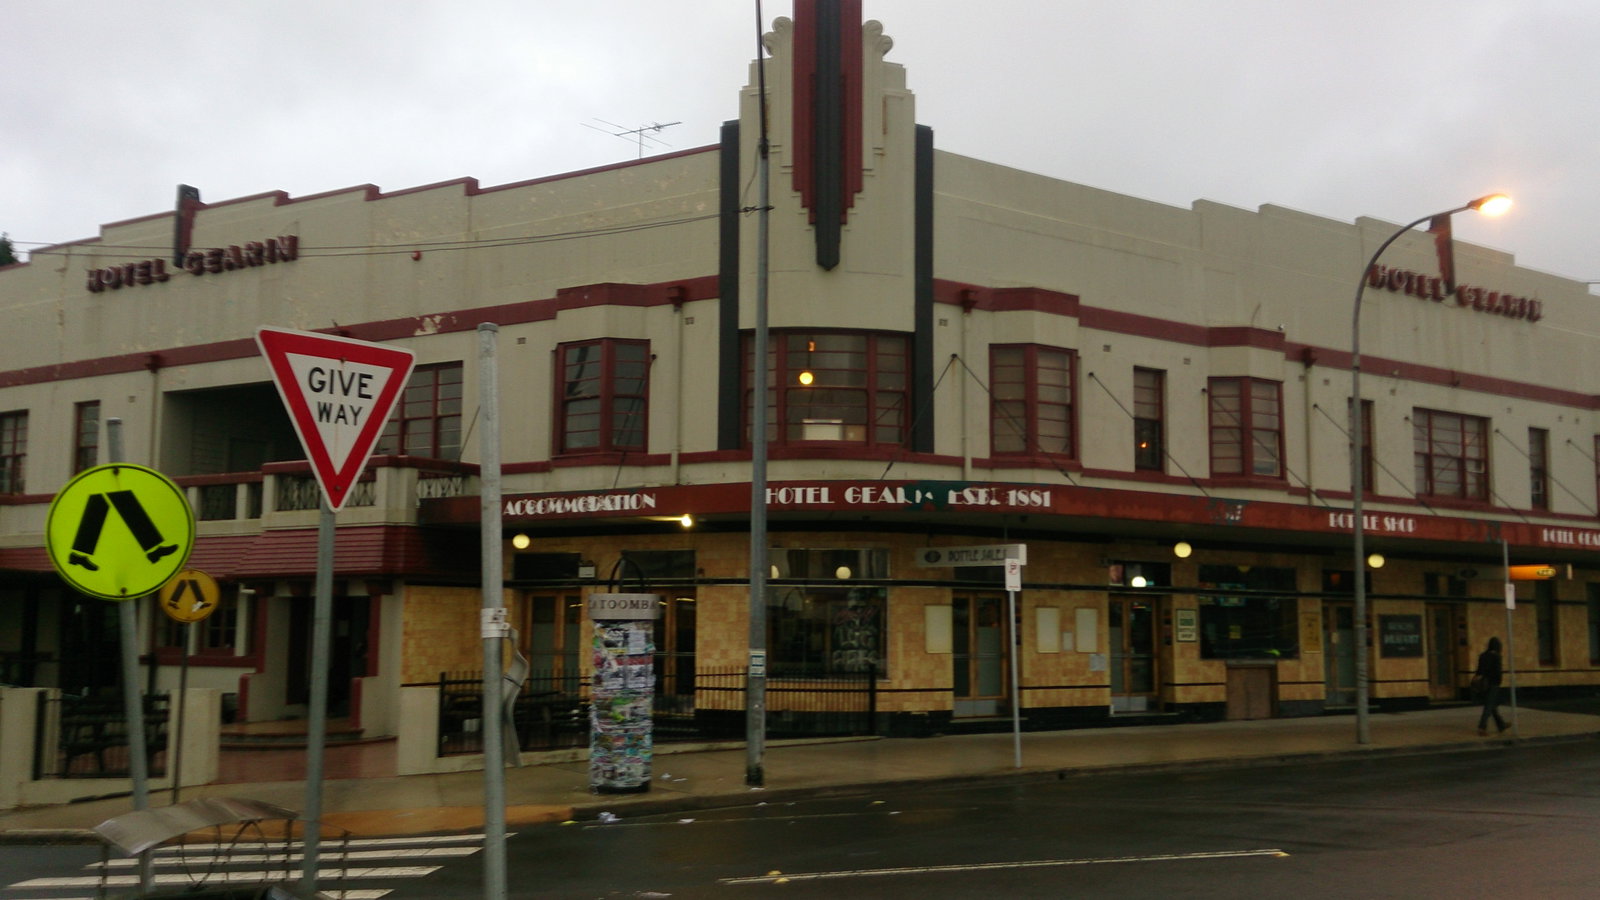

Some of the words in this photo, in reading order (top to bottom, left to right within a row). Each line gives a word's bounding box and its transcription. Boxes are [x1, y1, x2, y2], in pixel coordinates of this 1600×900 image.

[86, 257, 169, 293] HOTEL
[182, 235, 299, 276] GEARIN
[308, 366, 374, 400] GIVE
[317, 401, 364, 426] WAY
[766, 486, 834, 505] HOTEL
[1009, 488, 1051, 508] 1881
[1328, 512, 1380, 531] BOTLE
[1384, 515, 1416, 533] SHOP
[1542, 527, 1575, 545] HOTEL
